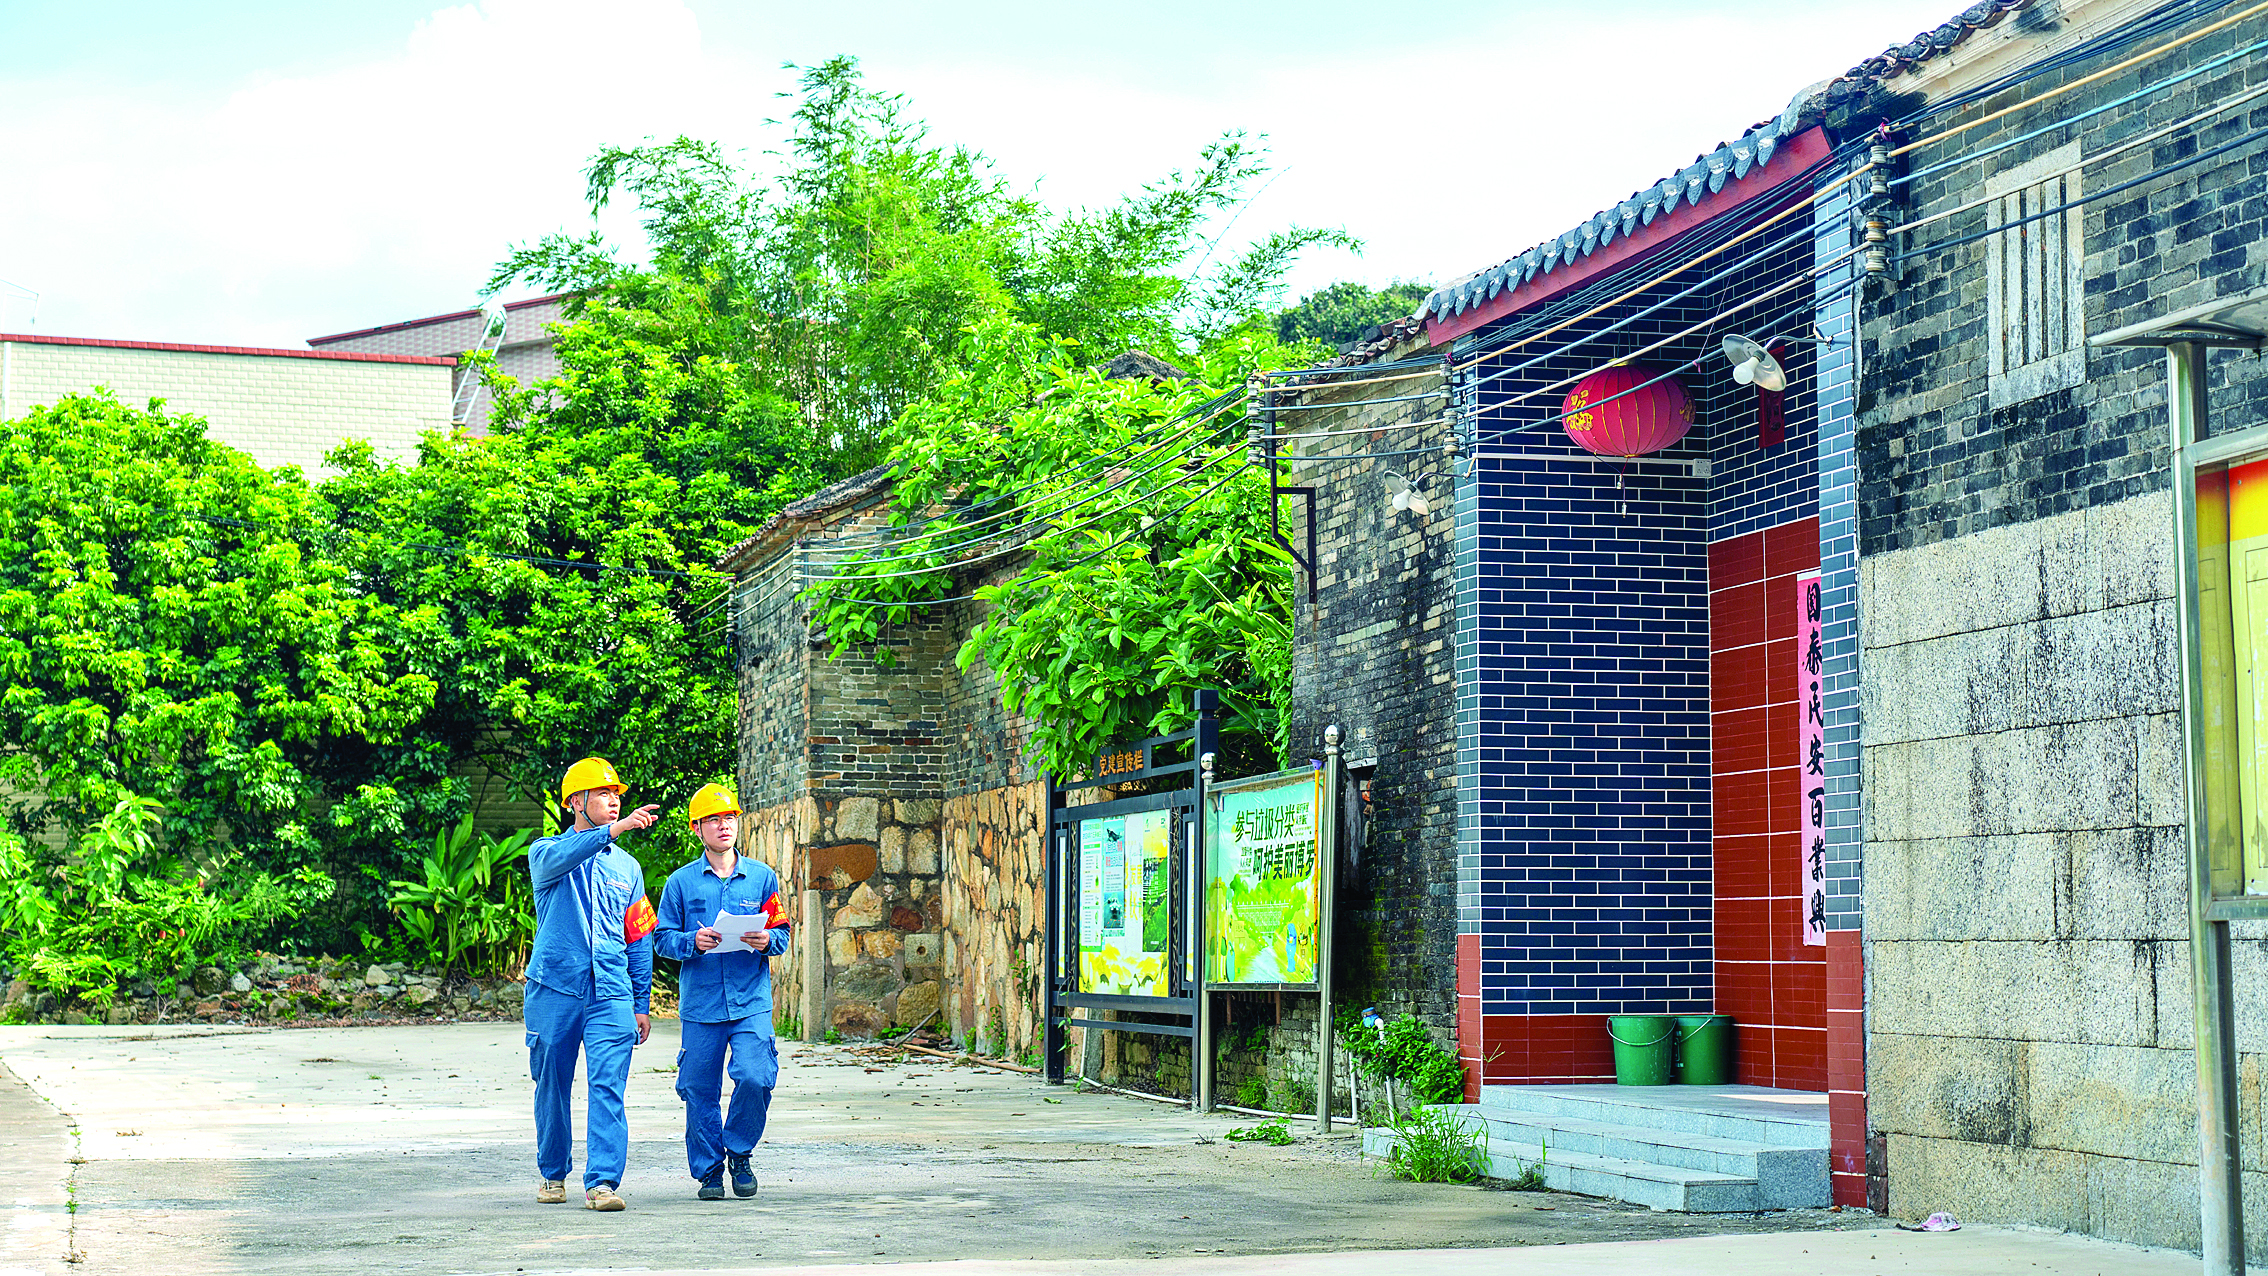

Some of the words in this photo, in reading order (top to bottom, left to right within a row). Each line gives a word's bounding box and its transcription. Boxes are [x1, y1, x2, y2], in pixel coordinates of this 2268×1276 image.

[1099, 749, 1144, 777] 党建宣传栏
[1235, 804, 1295, 842] 参与垃圾分类
[1253, 840, 1315, 881] 呵护美丽博罗
